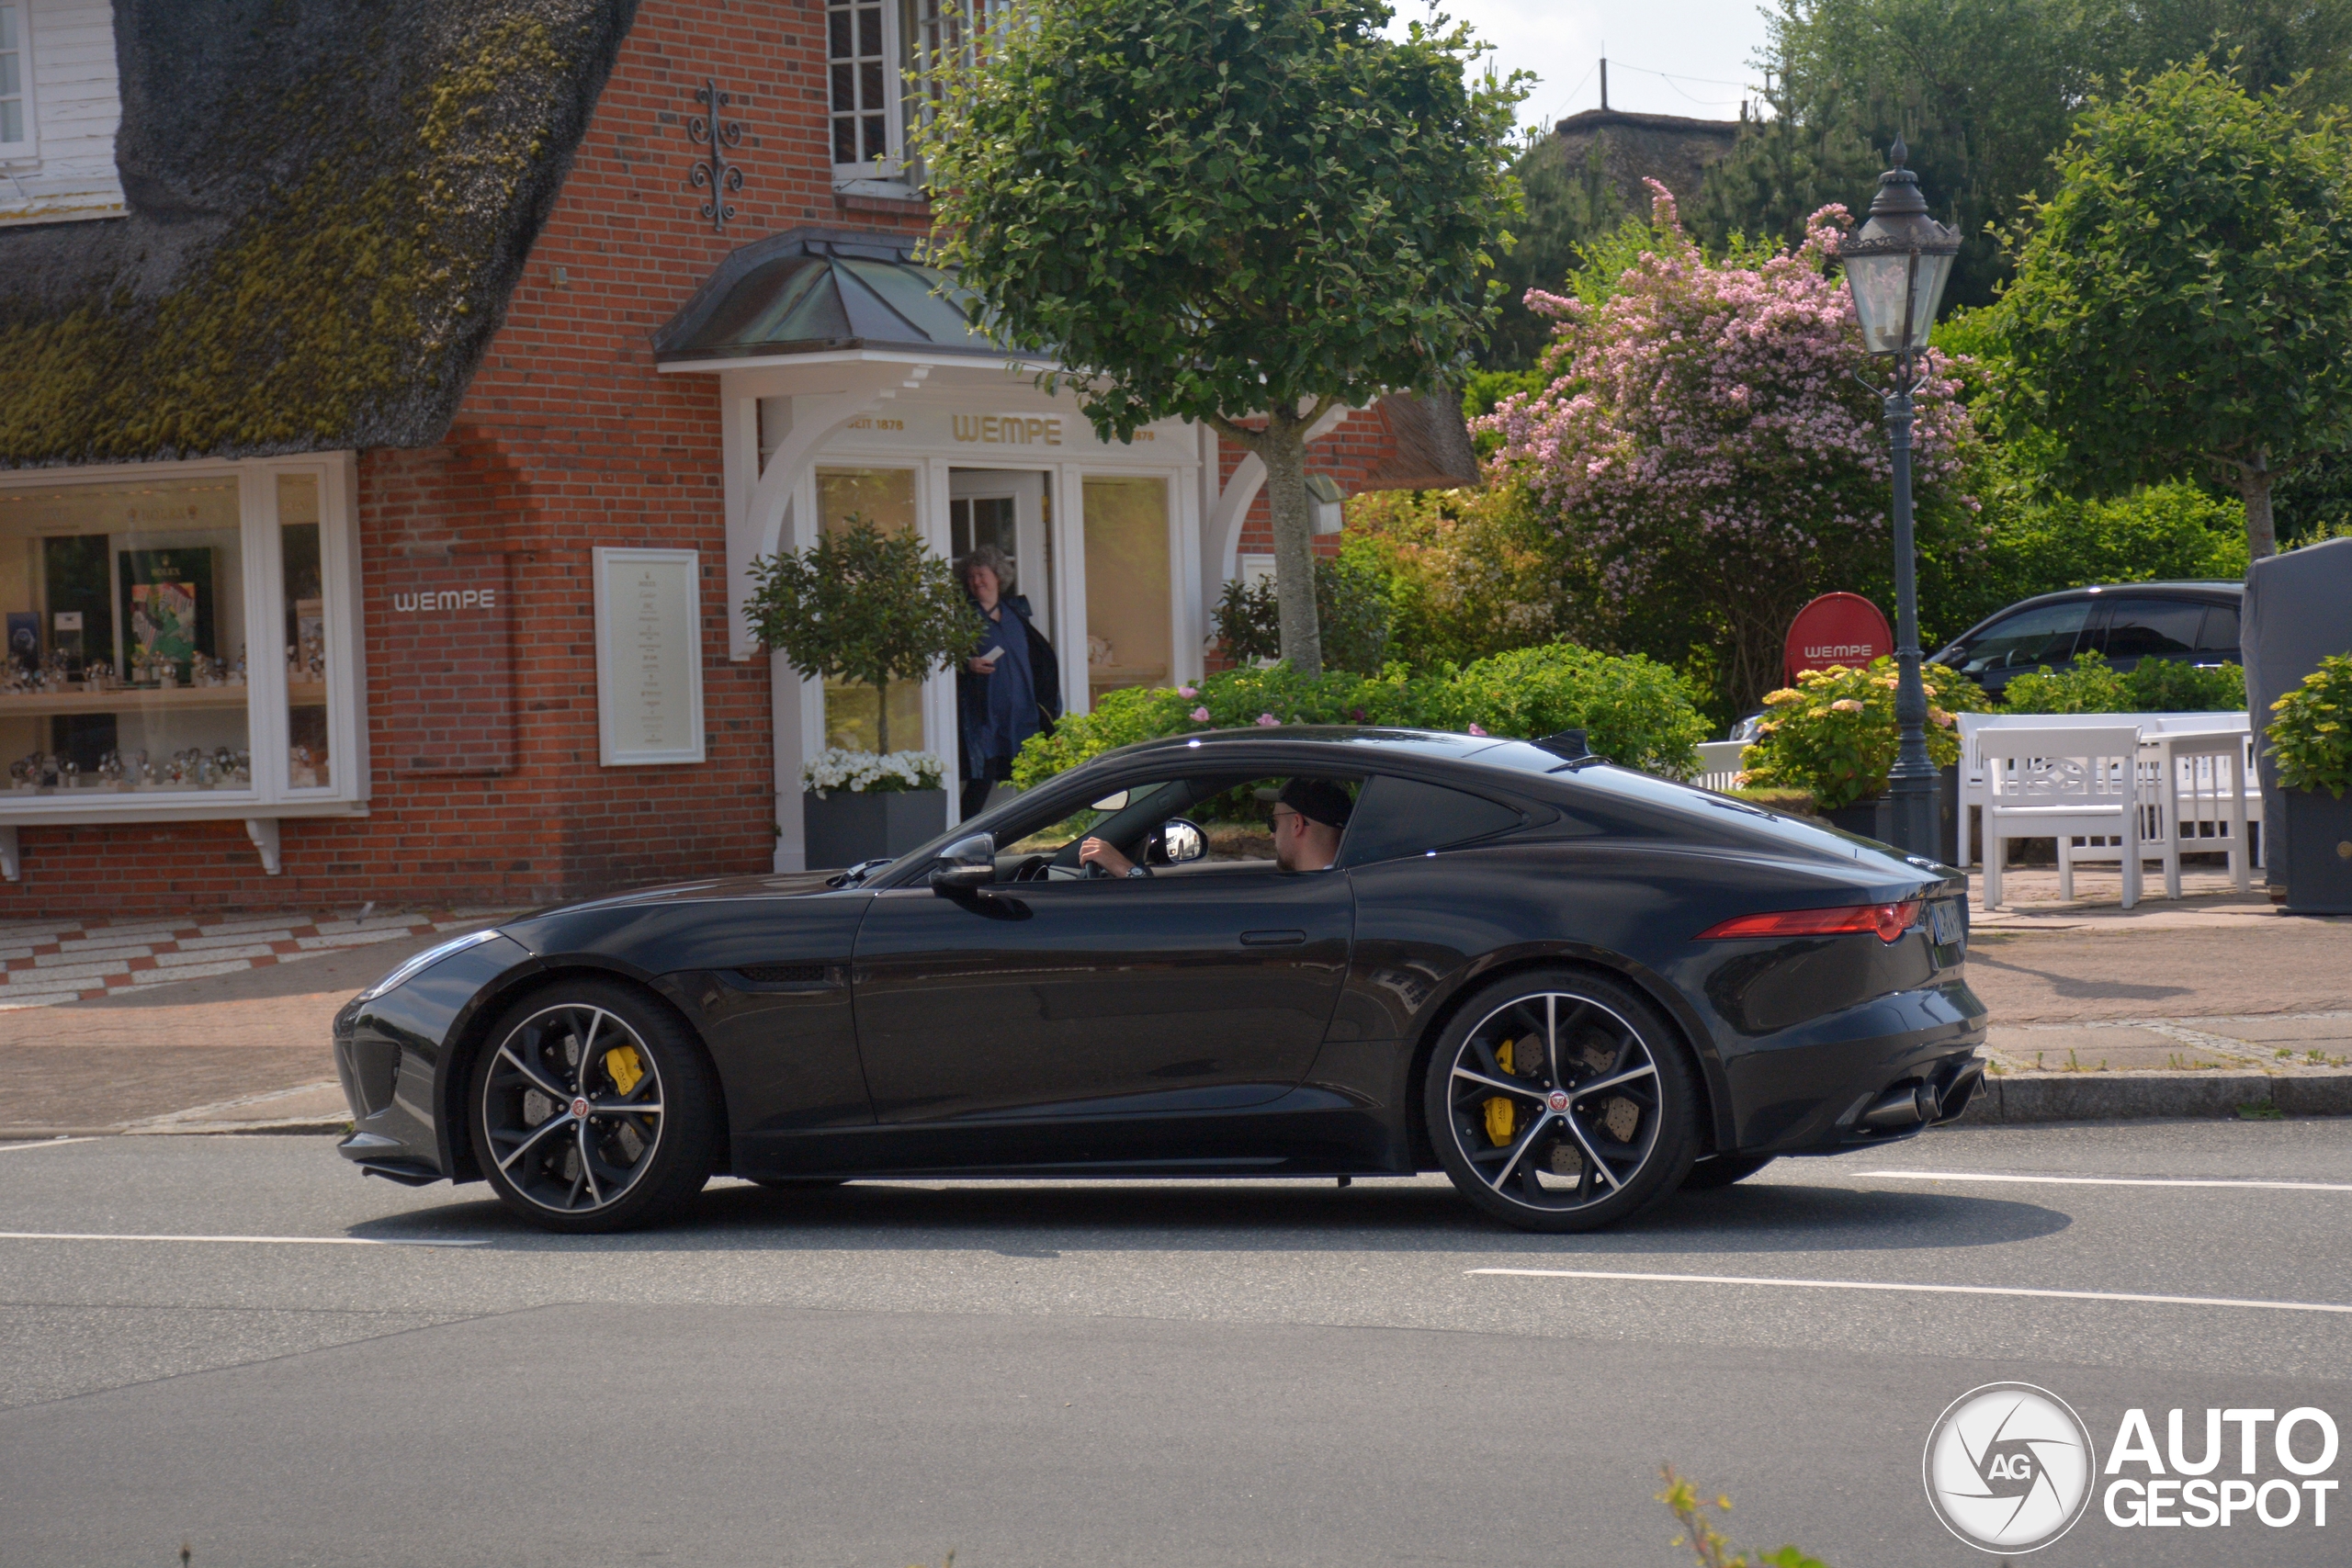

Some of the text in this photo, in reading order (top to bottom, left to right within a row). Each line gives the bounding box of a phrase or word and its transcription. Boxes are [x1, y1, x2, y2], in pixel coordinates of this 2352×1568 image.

[876, 419, 904, 431] 1878
[952, 414, 1062, 446] WEMPE
[393, 589, 495, 612] WEMPE
[1804, 645, 1872, 658] WEMPE
